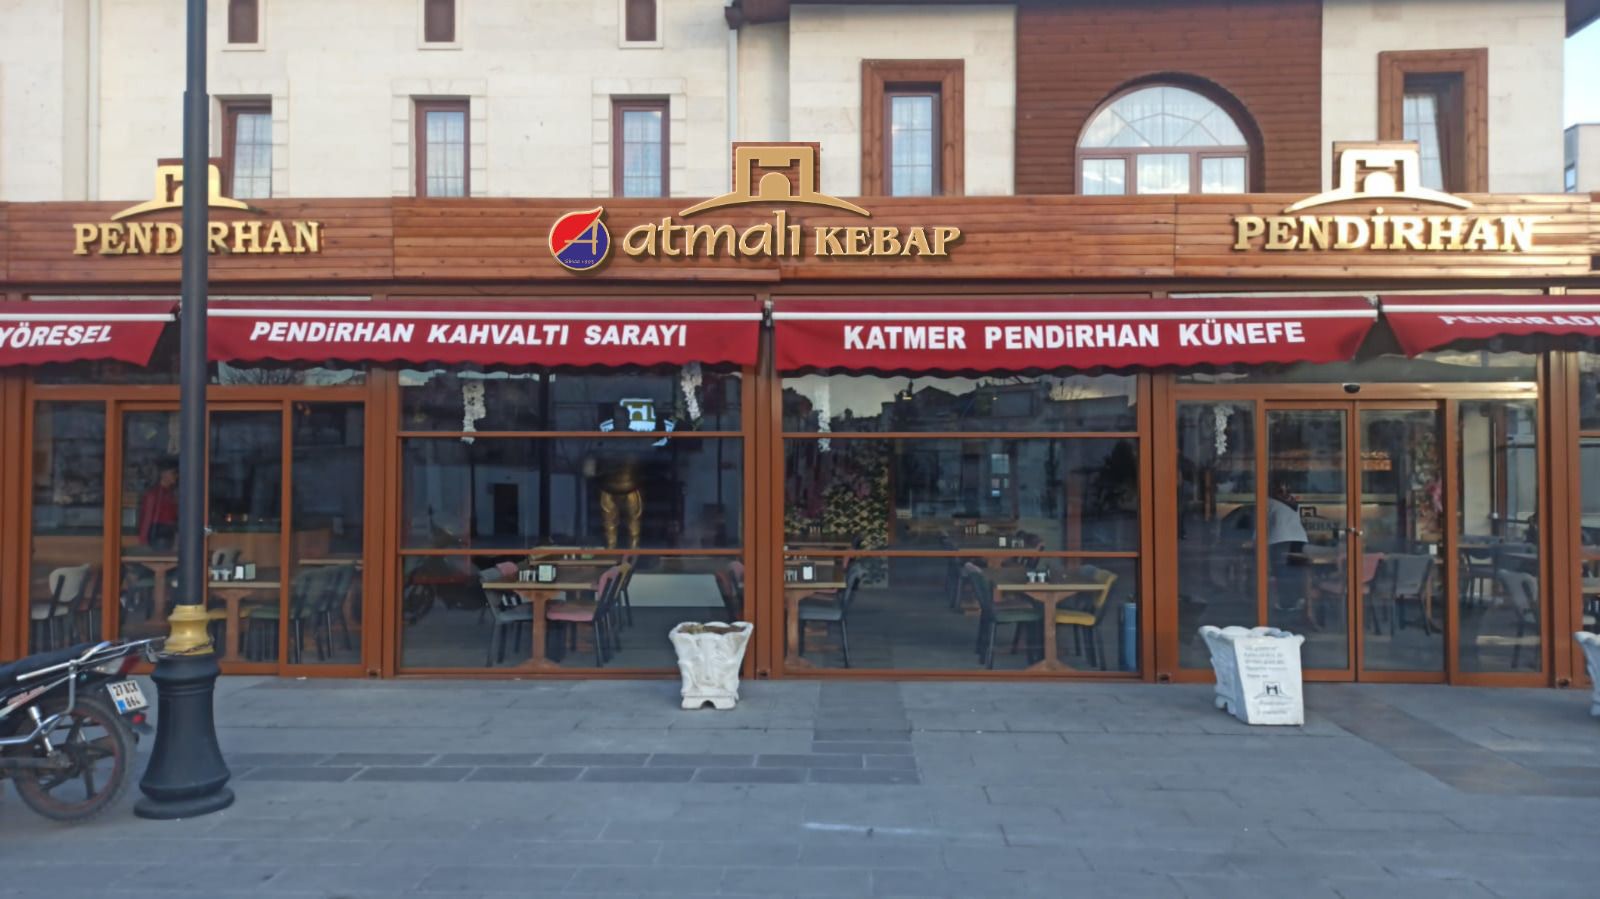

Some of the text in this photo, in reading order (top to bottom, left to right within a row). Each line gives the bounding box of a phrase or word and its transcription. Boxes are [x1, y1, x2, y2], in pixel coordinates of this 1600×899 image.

[73, 221, 321, 255] PENDRHAN
[814, 226, 961, 257] KEBAP
[427, 324, 570, 346] KAHVALTI
[583, 325, 688, 347] SARAYI
[843, 325, 967, 350] KATMER
[1178, 318, 1306, 347] KÜNEFE
[112, 684, 123, 697] 27
